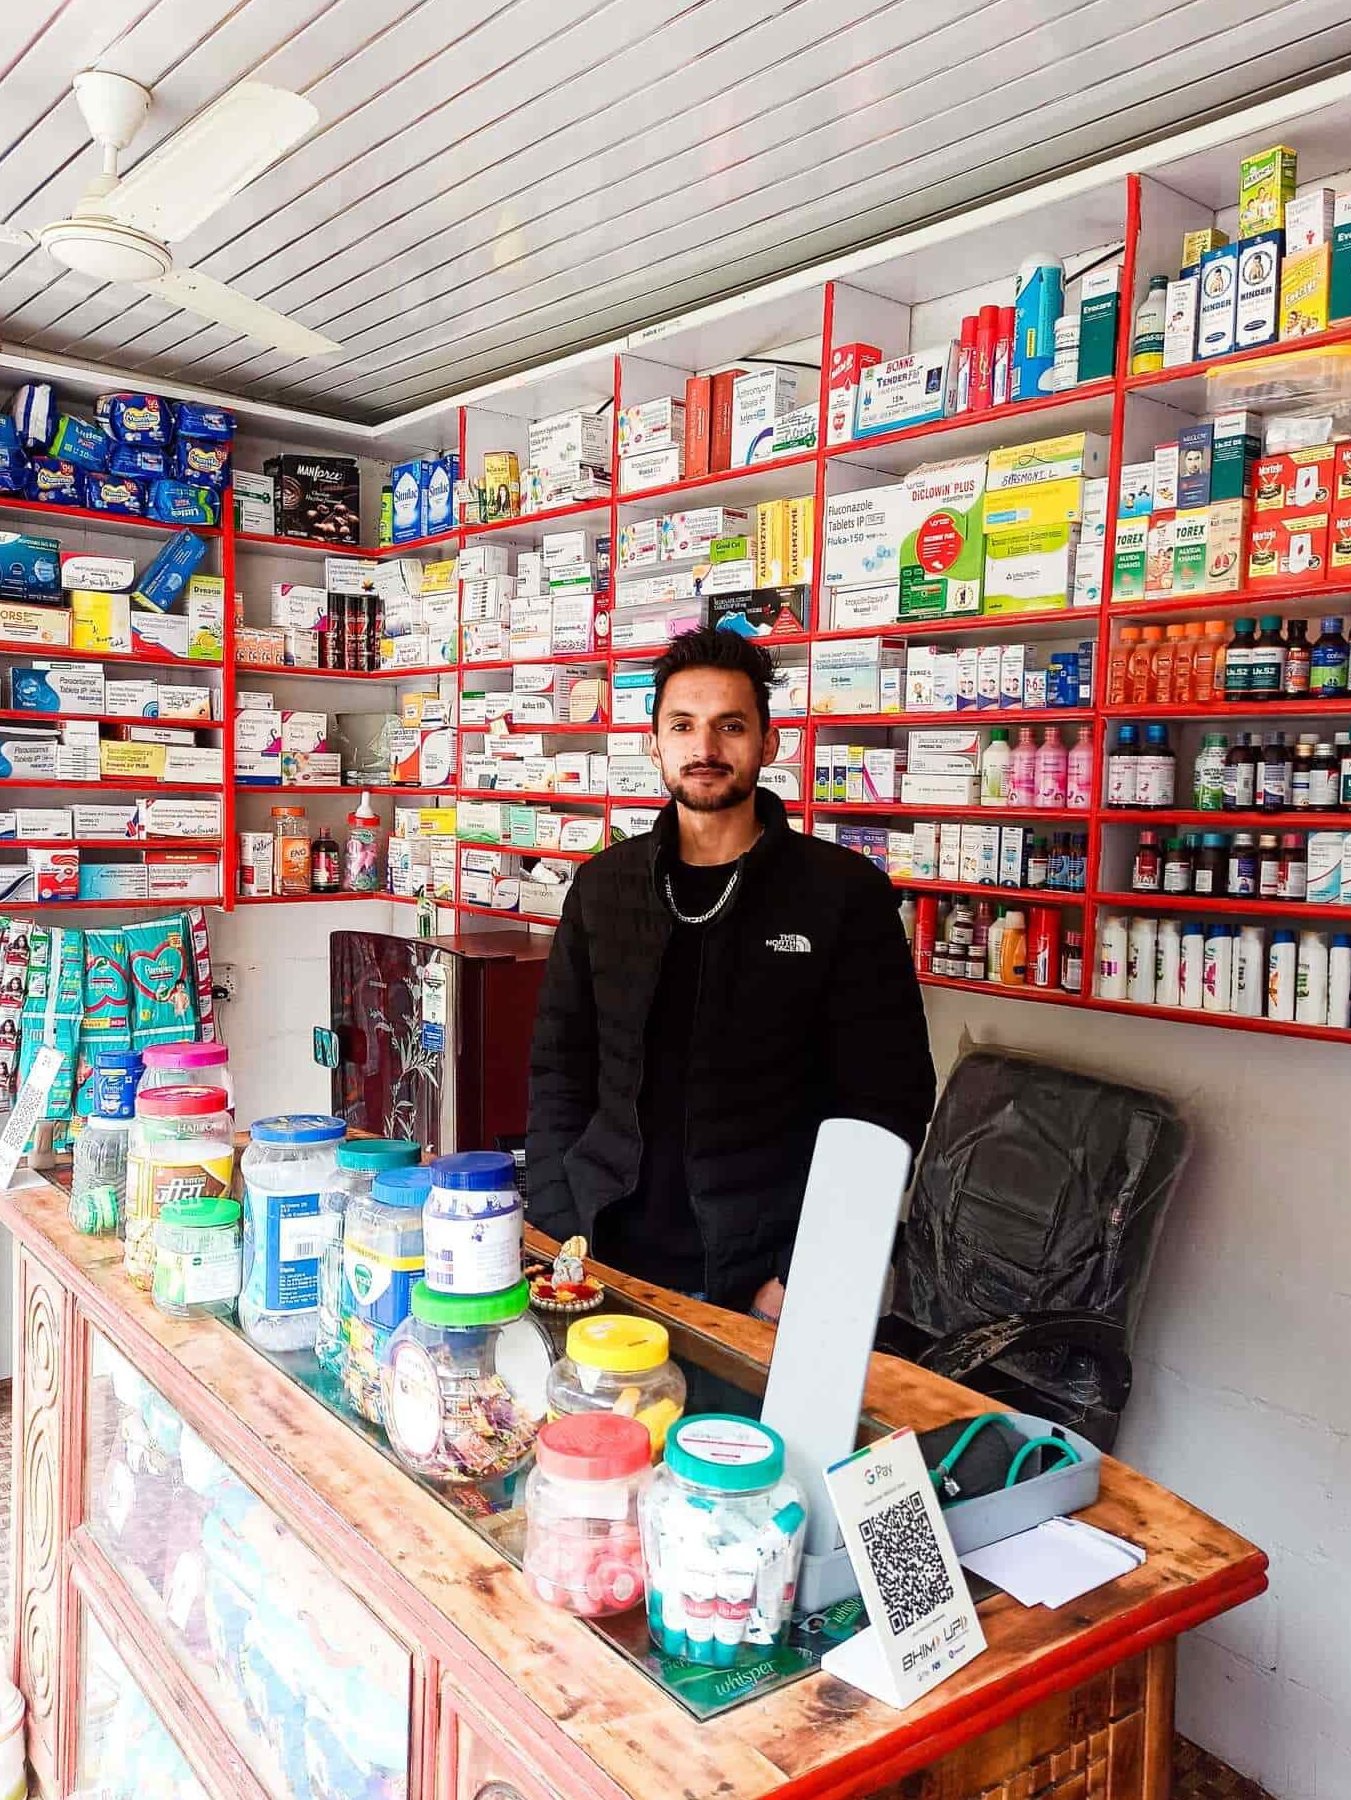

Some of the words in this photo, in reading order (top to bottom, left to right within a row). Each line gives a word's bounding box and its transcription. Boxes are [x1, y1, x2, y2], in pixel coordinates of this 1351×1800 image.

[954, 479, 975, 494] PLUS
[828, 499, 873, 516] Fluconazole
[828, 517, 855, 532] Tablets
[857, 515, 865, 527] IP
[827, 532, 864, 547] Fluka-150
[1116, 533, 1144, 546] TOREX
[1176, 525, 1206, 539] TOREX
[0, 609, 23, 621] ORS
[774, 775, 786, 783] 150
[765, 939, 796, 947] NORTH
[902, 1637, 937, 1672] BHIM
[715, 1661, 774, 1696] whisper
